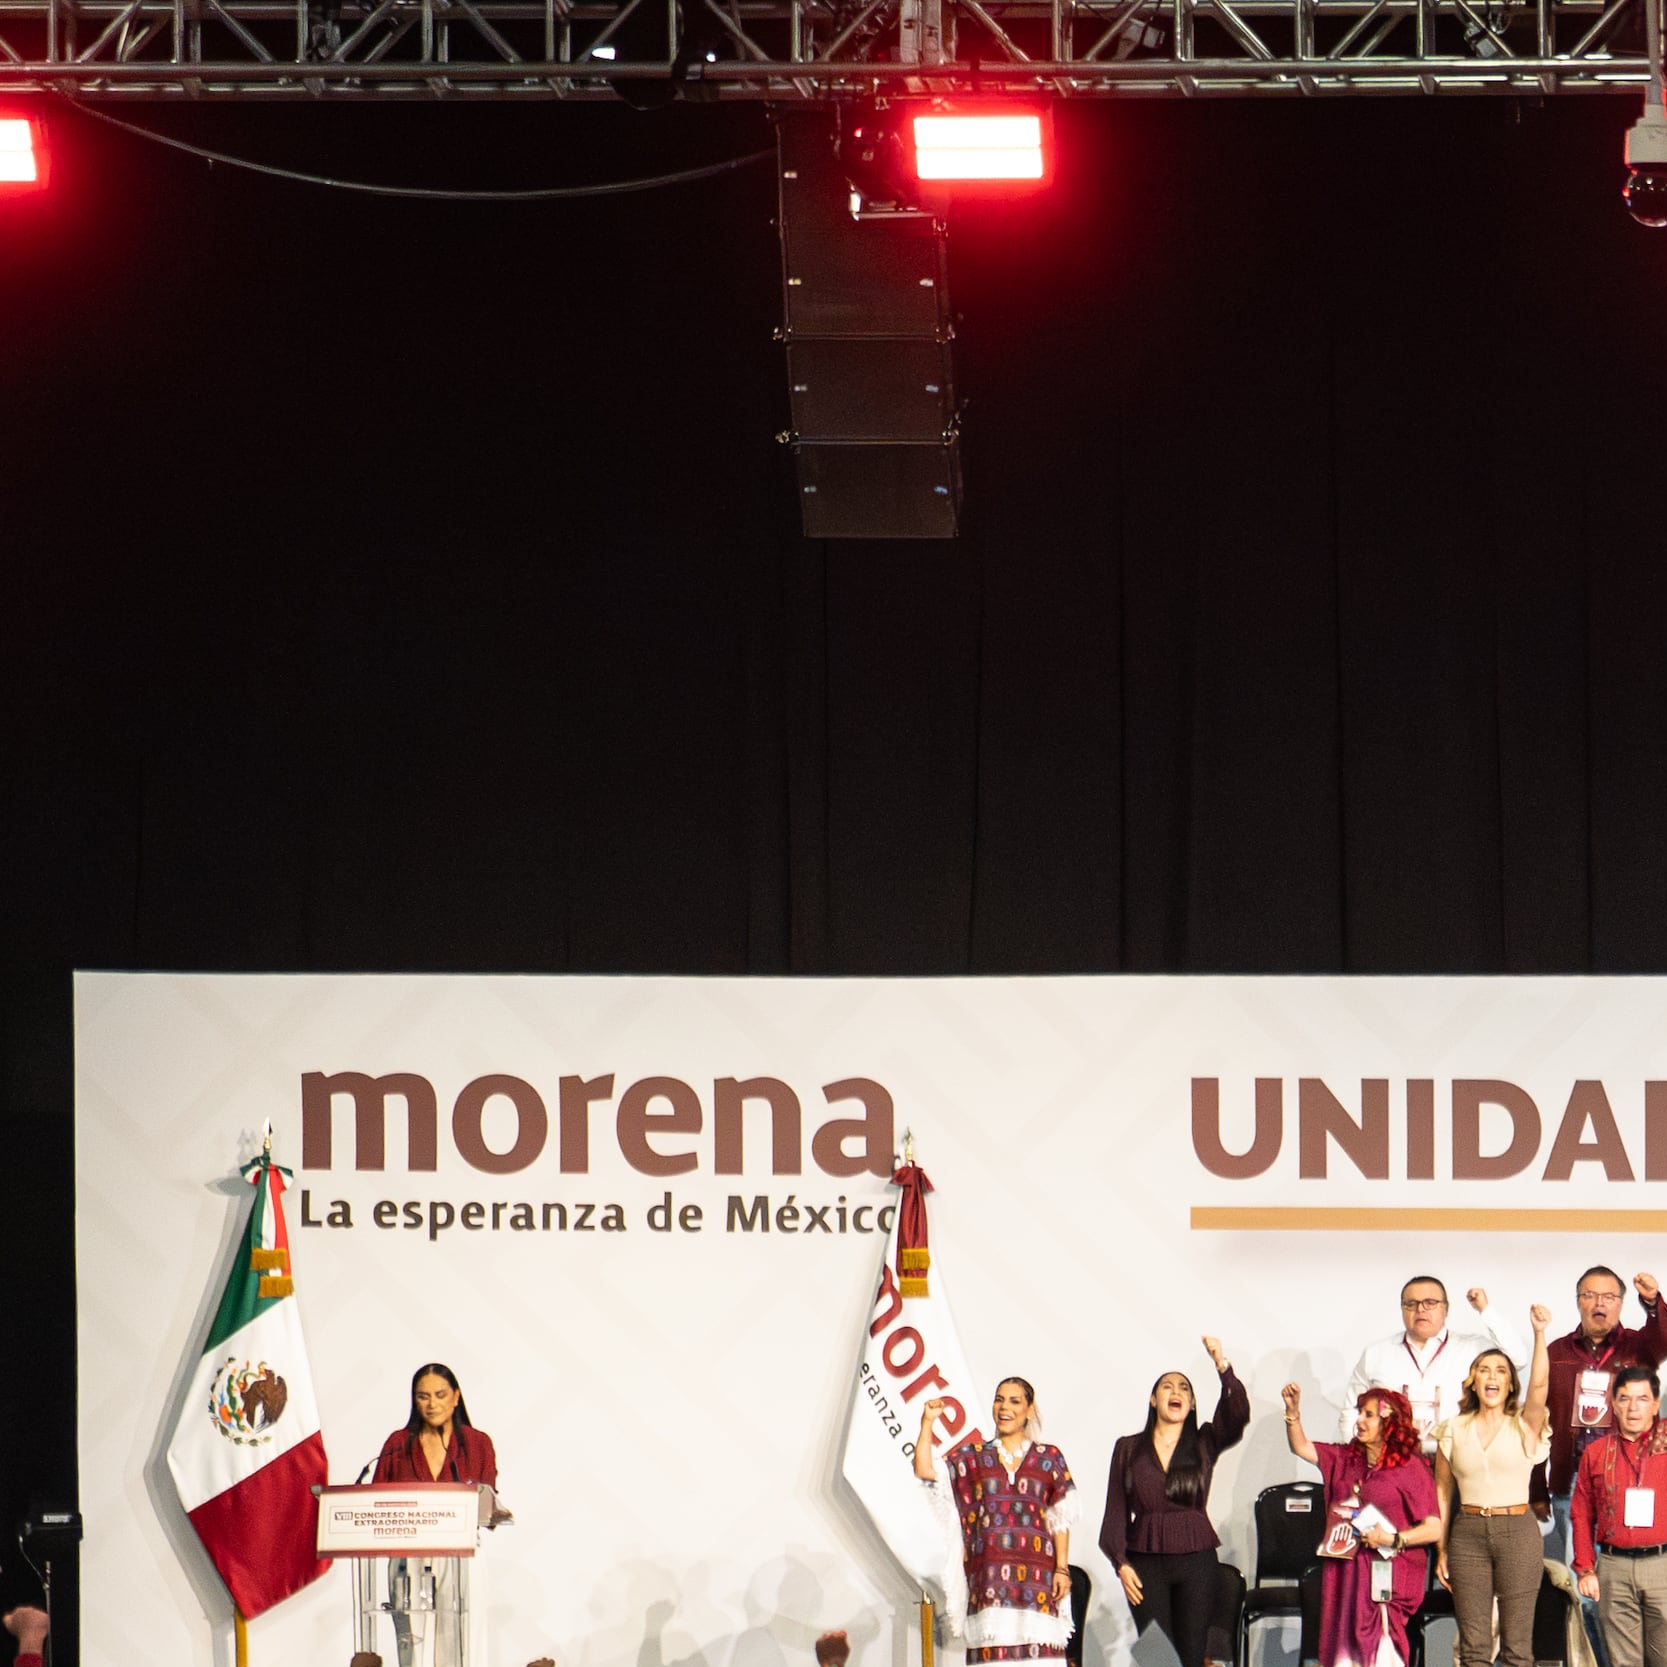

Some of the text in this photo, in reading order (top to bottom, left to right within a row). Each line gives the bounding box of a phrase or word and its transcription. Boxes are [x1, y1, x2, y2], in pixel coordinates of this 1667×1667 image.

[301, 1071, 894, 1177] morena
[301, 1189, 897, 1242] La esperanza de México
[354, 1511, 405, 1520] CONGRESO
[354, 1519, 439, 1527] EXTRAORDINARIO
[373, 1526, 418, 1536] morena
